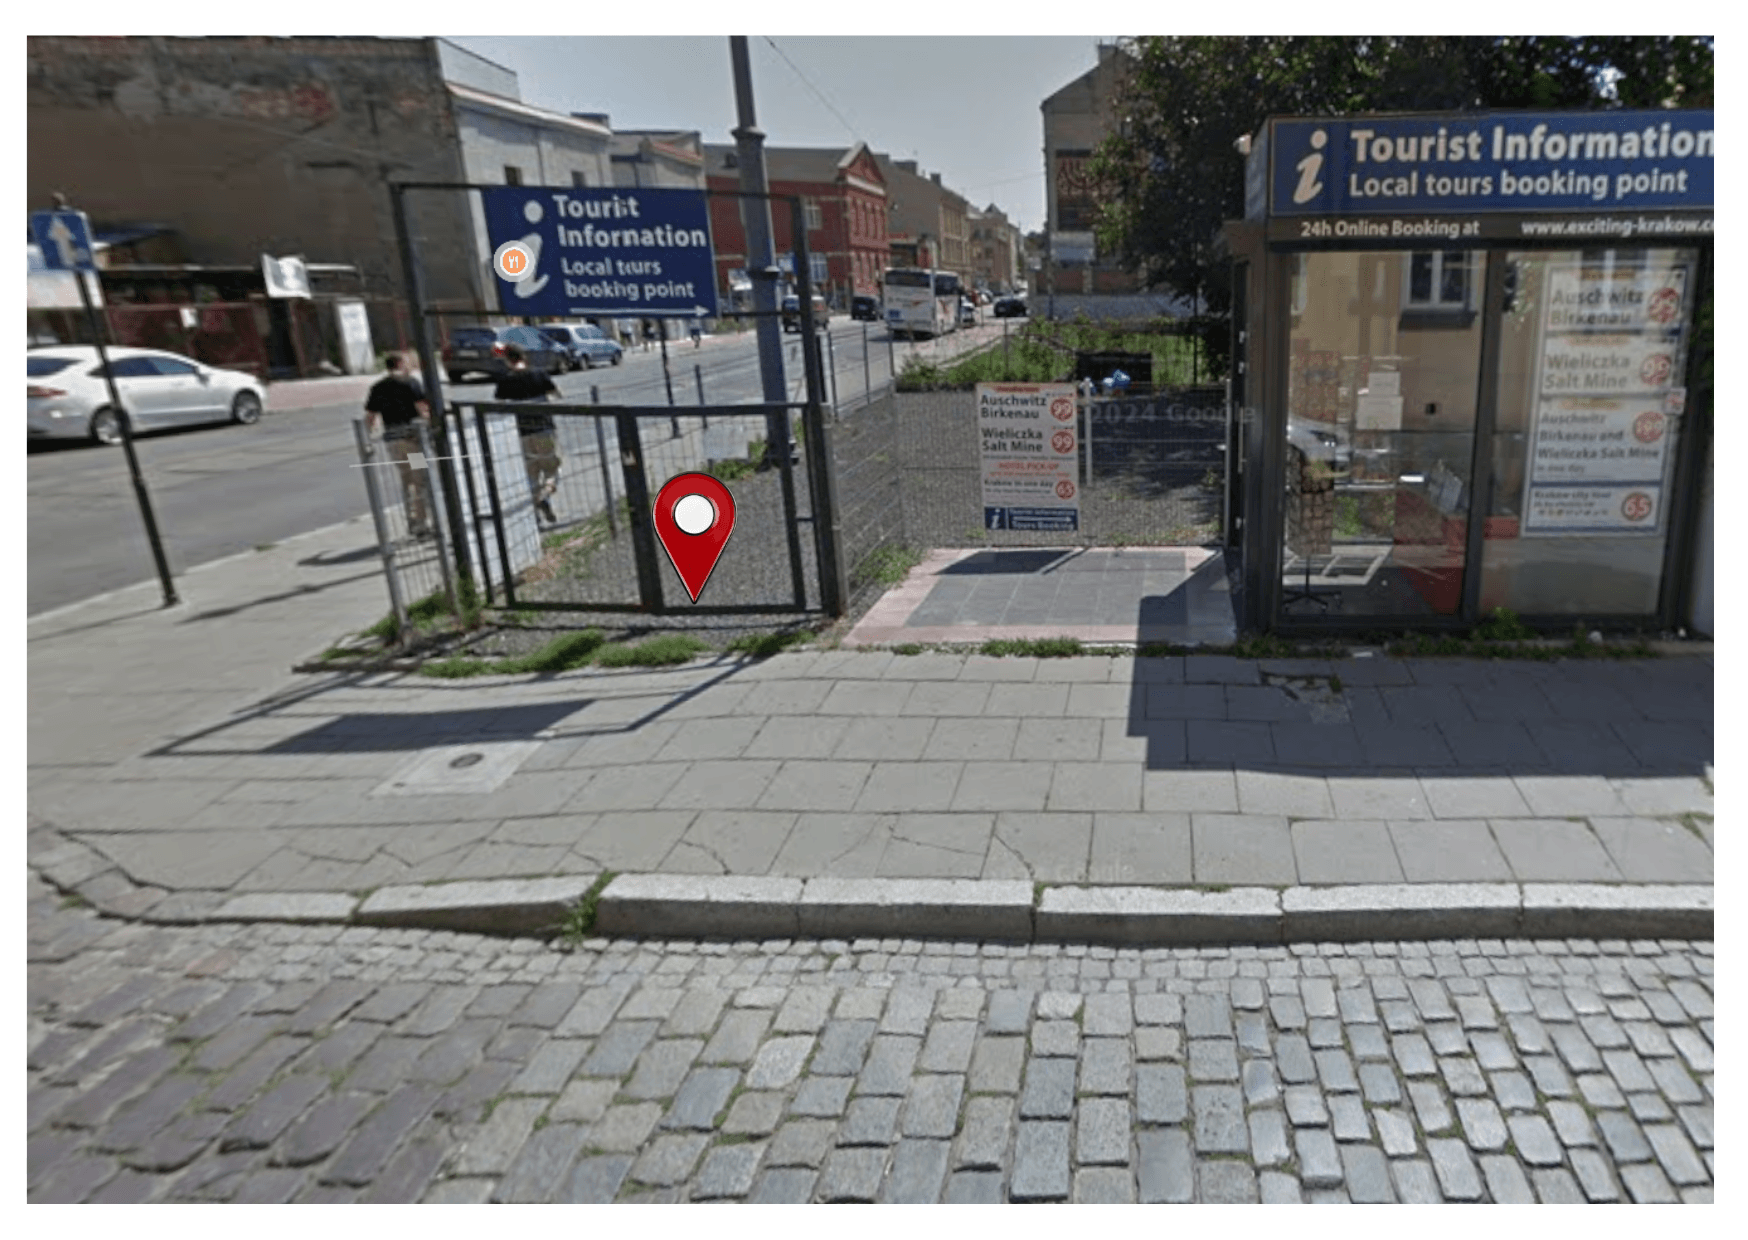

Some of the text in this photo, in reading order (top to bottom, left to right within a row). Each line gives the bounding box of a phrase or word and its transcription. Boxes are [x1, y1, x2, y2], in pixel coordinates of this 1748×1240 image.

[1350, 121, 1714, 162] Tourist Information
[1349, 167, 1689, 201] Local tours booking point
[1300, 219, 1481, 240] 24h Online Booking at
[1521, 215, 1714, 238] www.exciting-krakow.c
[560, 256, 614, 277] Local
[643, 280, 696, 302] point
[1546, 350, 1632, 370] Wieliczka
[1543, 371, 1628, 390] Salt Mine
[980, 394, 1047, 406] Auschwitz
[980, 406, 1040, 419] Birkenau
[980, 427, 1043, 439] Wieliczka
[982, 440, 1043, 452] Salt Mine
[1625, 497, 1651, 517] 65
